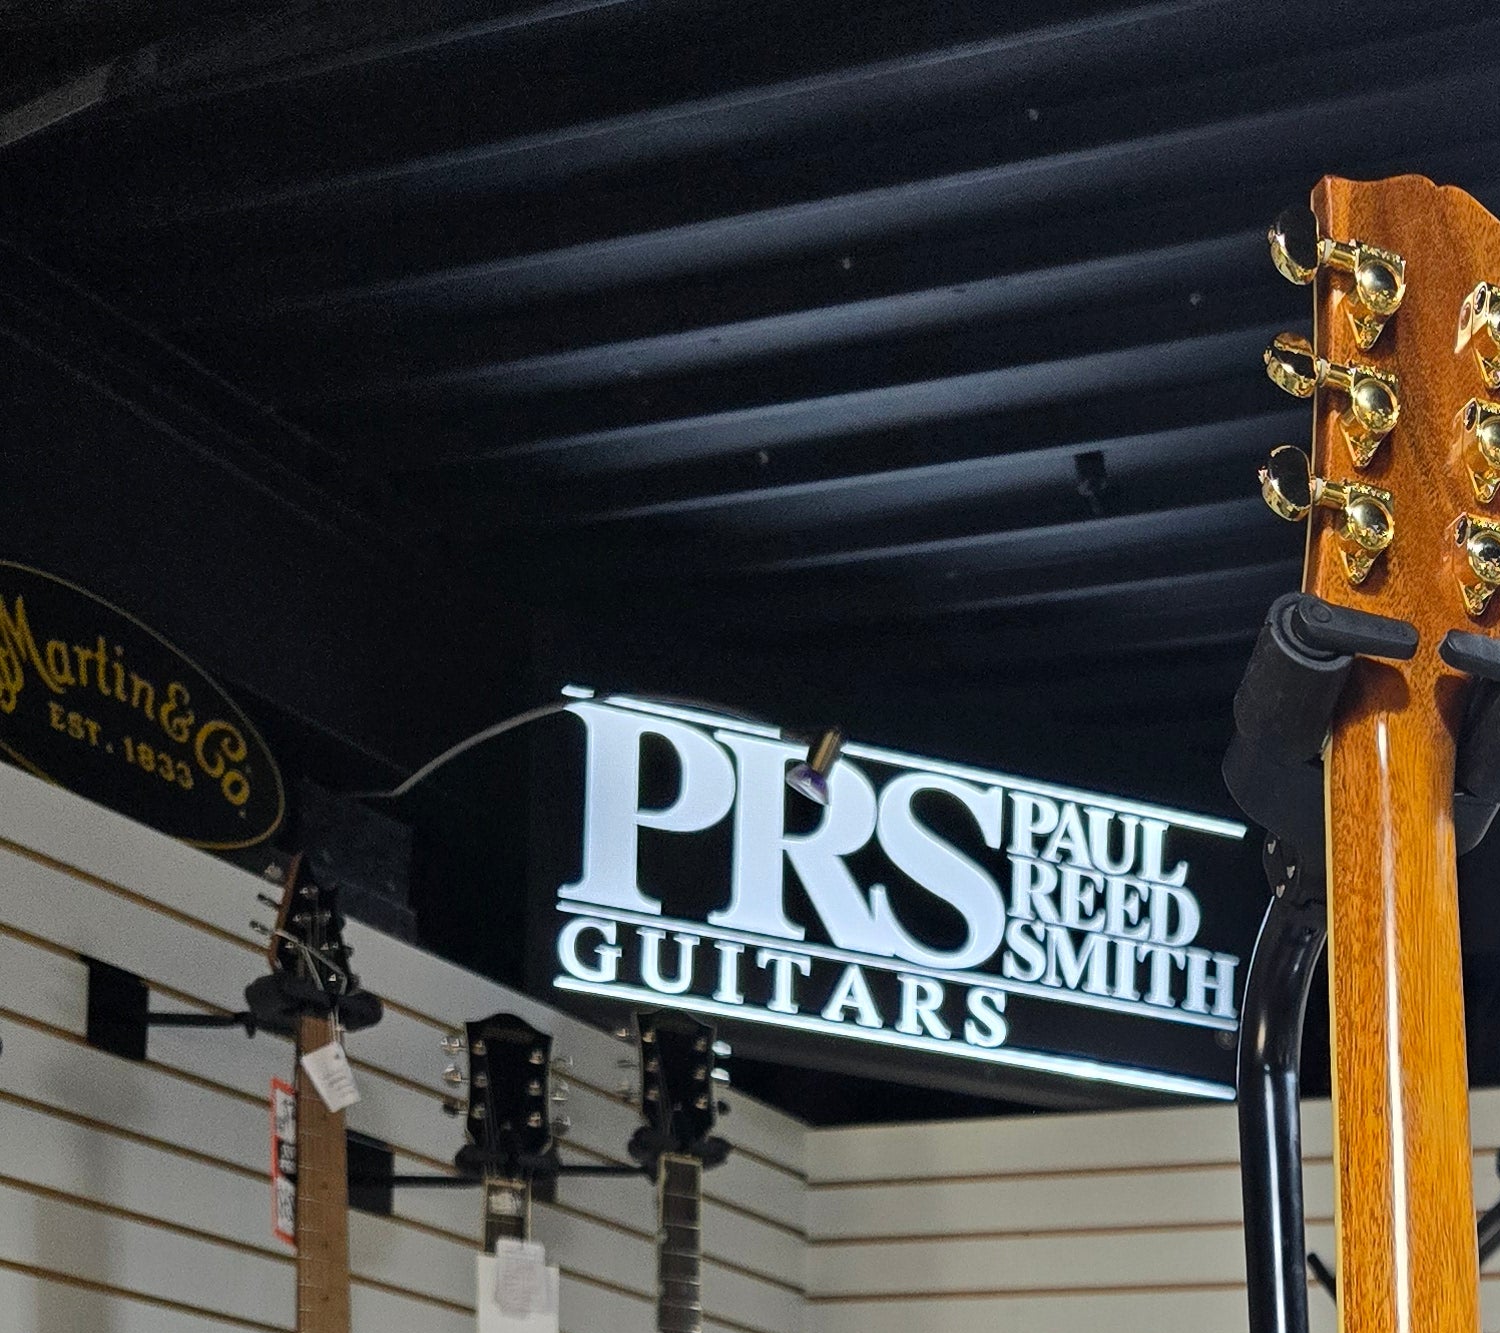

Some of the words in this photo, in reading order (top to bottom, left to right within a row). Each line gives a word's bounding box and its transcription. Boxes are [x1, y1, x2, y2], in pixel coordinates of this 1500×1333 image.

[557, 700, 1006, 971] PRS
[1008, 790, 1189, 888] PAUL
[1006, 854, 1201, 948] REED
[556, 915, 1009, 1050] GUITARS
[1003, 921, 1240, 1019] SMITH
